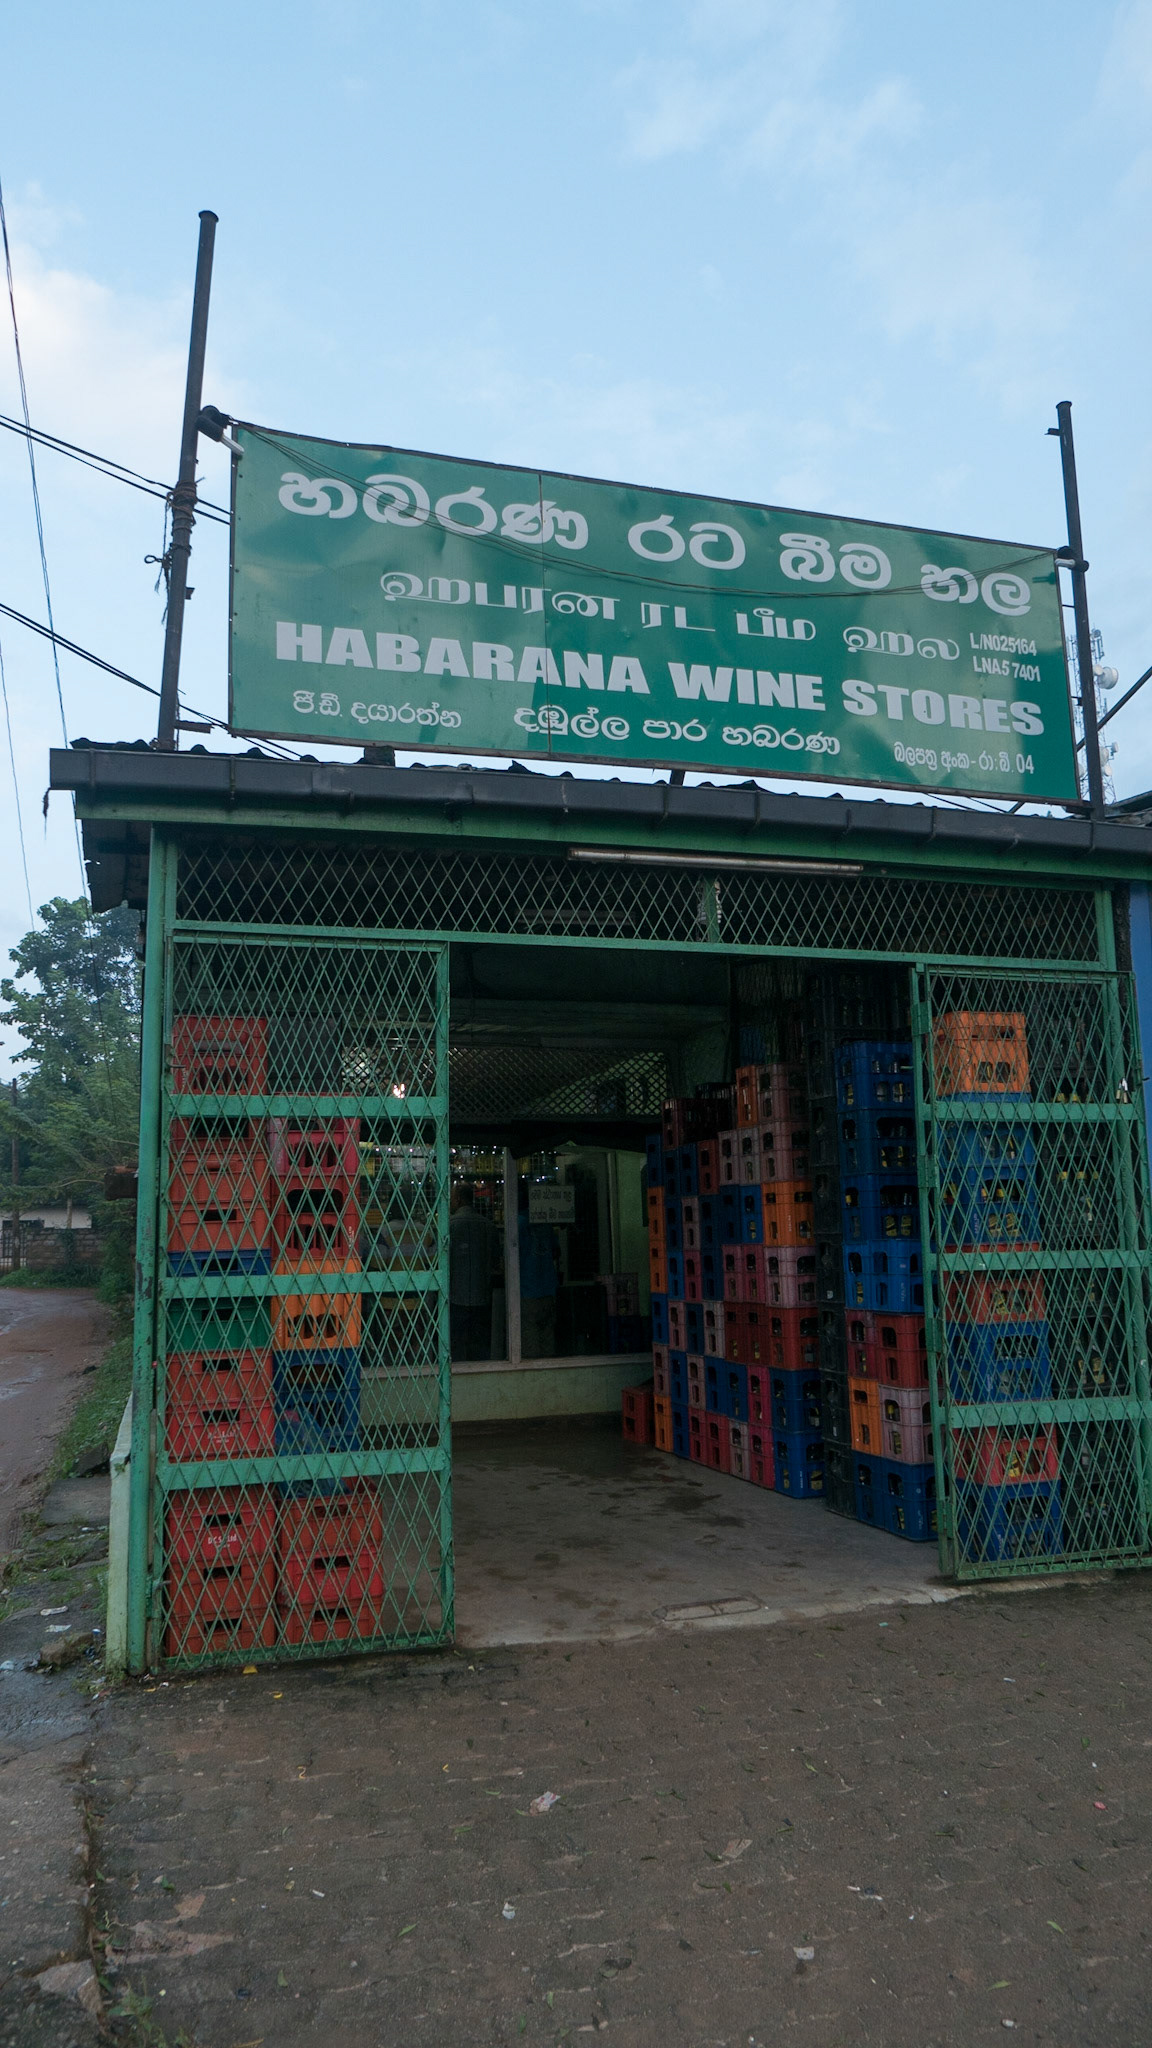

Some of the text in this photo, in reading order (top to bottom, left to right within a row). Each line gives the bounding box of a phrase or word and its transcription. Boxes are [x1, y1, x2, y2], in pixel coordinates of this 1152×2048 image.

[278, 472, 1032, 616] හබරණ රට බීම හල
[641, 602, 716, 632] ரட
[275, 621, 1045, 736] HABARANA WINE STORES
[350, 701, 462, 729] දයාරත්න
[513, 704, 841, 756] දඹුල්ල පාර හබරණ
